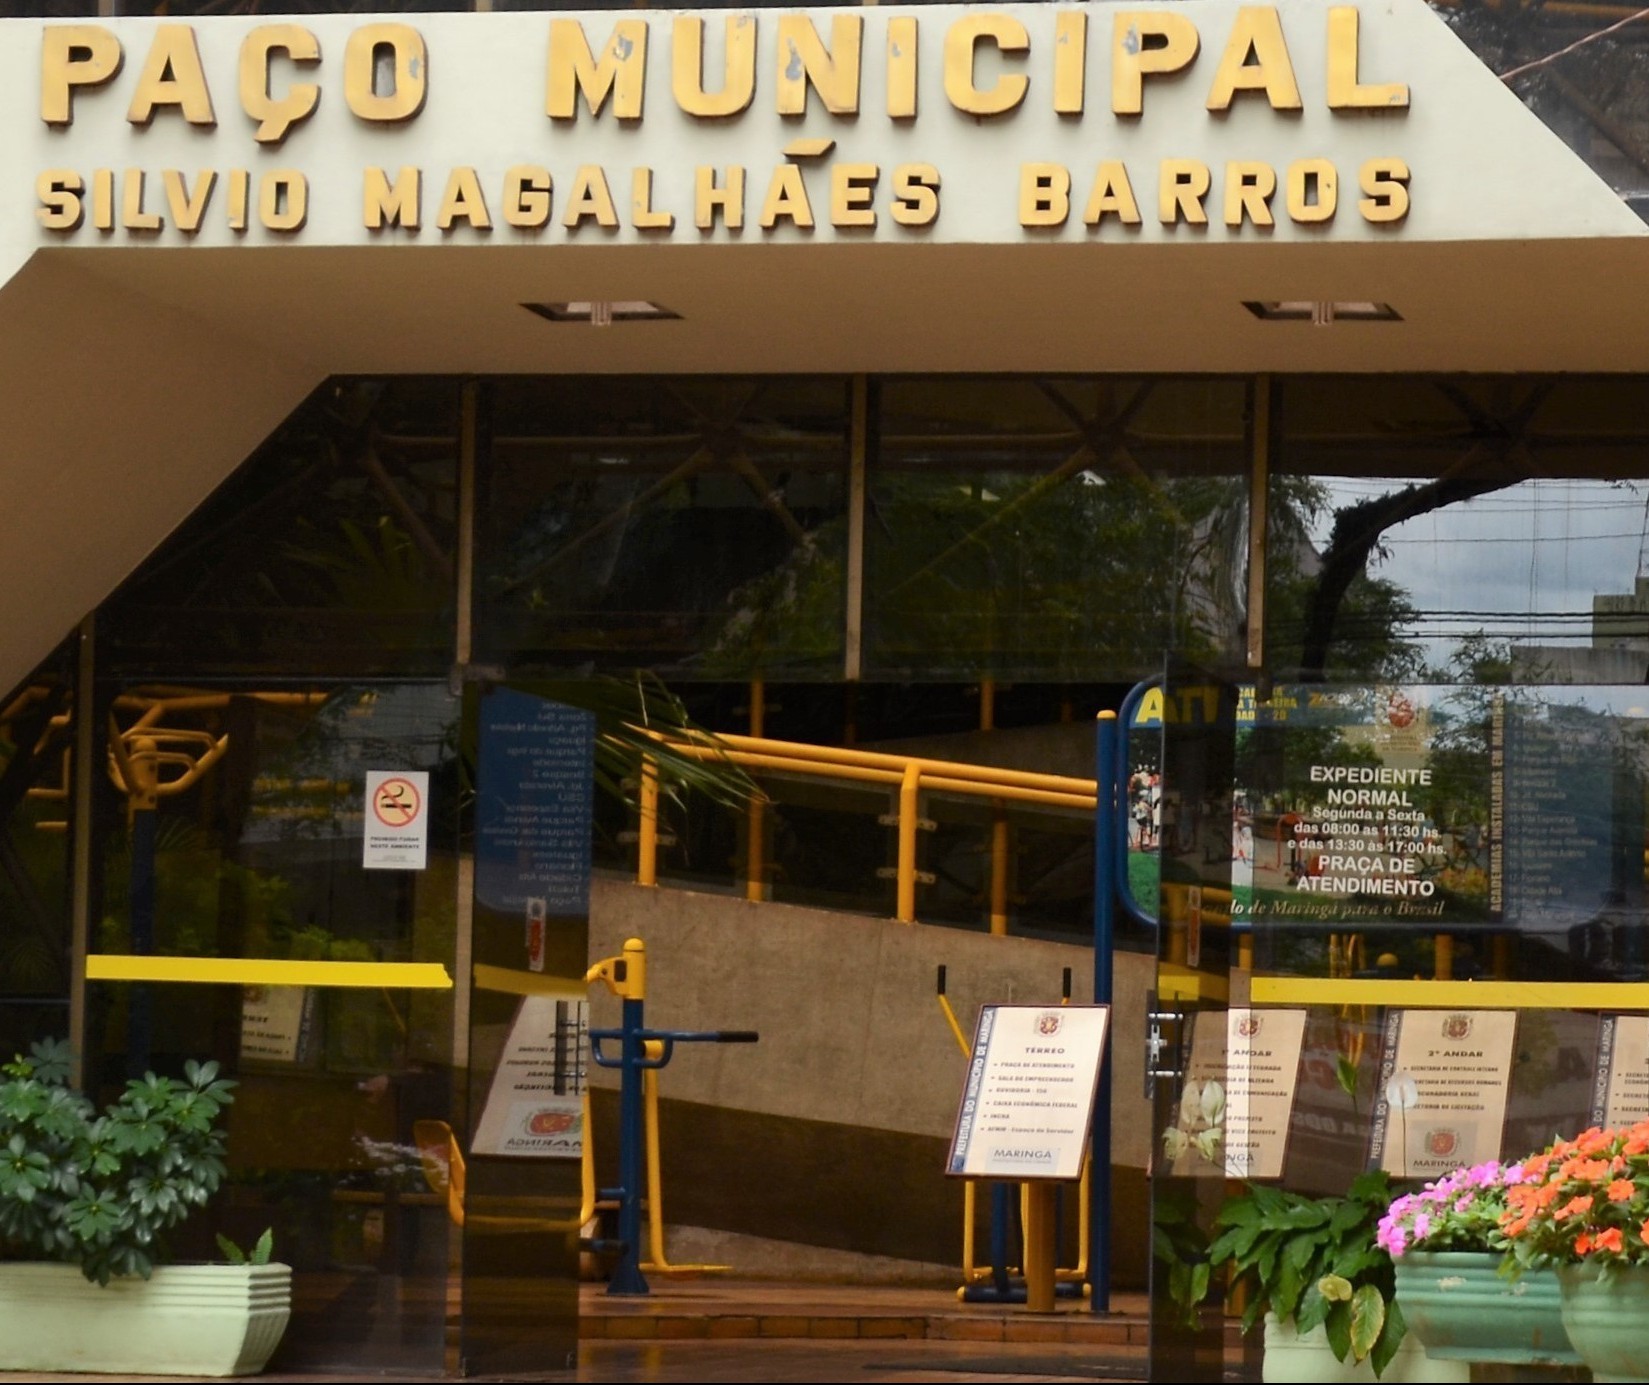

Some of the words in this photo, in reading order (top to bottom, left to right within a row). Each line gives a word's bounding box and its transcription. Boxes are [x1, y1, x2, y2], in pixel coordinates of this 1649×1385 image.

[40, 22, 428, 146] PAÇO
[546, 5, 1410, 121] MUNICIPAL
[36, 167, 309, 233] SILVIO
[1018, 156, 1411, 229] BARROS
[1310, 765, 1432, 786] EXPEDIENTE
[1327, 788, 1413, 807] NORMAL
[1491, 771, 1503, 840] INSTALADAS
[1312, 806, 1372, 821] Segunda
[1375, 810, 1384, 820] a
[1387, 808, 1425, 822] Sexta
[1294, 821, 1322, 834] das
[1321, 822, 1360, 835] 08:00
[1382, 825, 1420, 838] 11:30
[1287, 840, 1296, 849] e
[1299, 838, 1324, 850] das
[1327, 839, 1365, 851] 13:30
[1387, 841, 1425, 854] 17:00
[1318, 855, 1384, 875] PRAÇA
[1389, 858, 1416, 874] DE
[1296, 875, 1435, 897] ATENDIMENTO
[1490, 843, 1503, 912] ACADEMIAS
[1248, 899, 1265, 915] de
[1270, 900, 1338, 919] Maringá
[1340, 903, 1379, 919] para
[1382, 904, 1392, 915] o
[1385, 1049, 1395, 1059] DE
[1600, 1055, 1610, 1065] DE
[955, 1115, 973, 1156] PREFEITURA
[966, 1100, 976, 1112] DO
[976, 1046, 987, 1056] DE
[1376, 1103, 1387, 1115] DO
[1370, 1119, 1386, 1159] PREFEITURA
